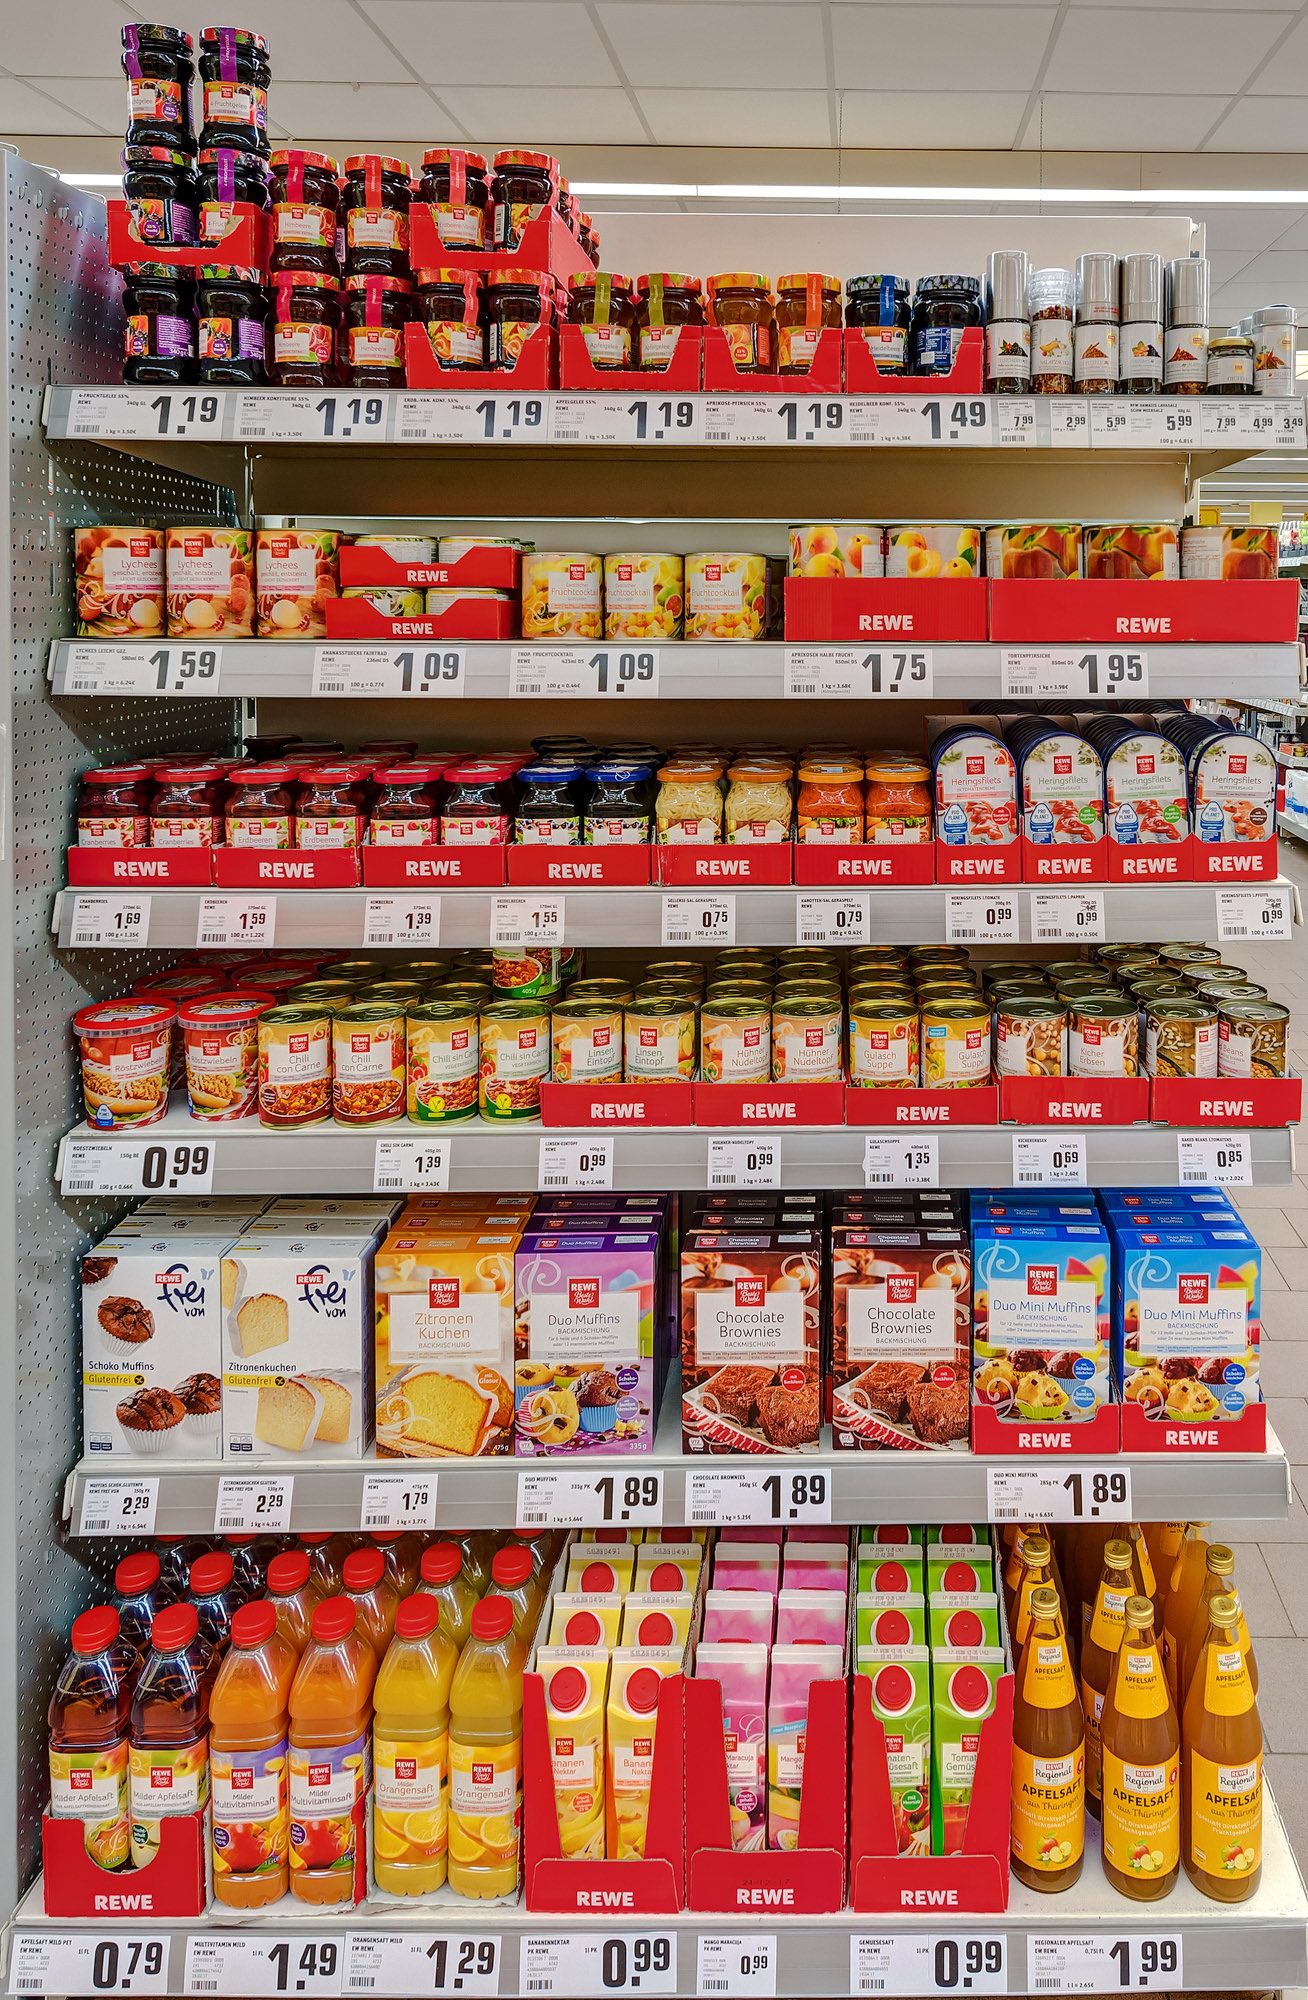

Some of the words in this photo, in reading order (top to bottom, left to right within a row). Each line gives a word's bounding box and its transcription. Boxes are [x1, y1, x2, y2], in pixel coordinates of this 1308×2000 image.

[150, 396, 218, 434] 1.19
[315, 398, 383, 436] 1.19
[476, 400, 542, 438] 1.19
[627, 401, 693, 439] 1.19
[777, 403, 843, 440] 1.19
[921, 402, 986, 439] 1.49
[1014, 416, 1033, 427] 7.99
[1066, 417, 1086, 428] 2.99
[1106, 417, 1126, 428] 5.99
[1167, 415, 1192, 431] 5.99
[1217, 417, 1236, 430] 7.99
[1253, 418, 1273, 429] 4.99
[1283, 418, 1303, 429] 3.49
[121, 560, 158, 569] Lychees
[178, 560, 212, 569] Lychees
[407, 570, 448, 582] REWE
[392, 623, 433, 635] REWE
[859, 615, 914, 631] REWE
[1116, 617, 1171, 633] REWE
[149, 650, 216, 690] 1.59
[393, 652, 460, 692] 1.09
[588, 653, 654, 692] 1.09
[861, 654, 926, 693] 1.75
[1078, 654, 1142, 693] 1.95
[951, 777, 1001, 788] Heringsfilets
[1038, 776, 1088, 786] Heringsfilets
[1211, 776, 1262, 785] Heringsfilets
[81, 838, 116, 846] Cranberries
[238, 836, 273, 844] Erdbeeren
[114, 862, 169, 877] REWE
[259, 863, 315, 878] REWE
[406, 861, 461, 876] REWE
[548, 864, 603, 878] REWE
[695, 860, 750, 875] REWE
[838, 860, 892, 875] REWE
[950, 859, 1005, 875] REWE
[1038, 858, 1092, 875] REWE
[1123, 857, 1178, 874] REWE
[1208, 855, 1263, 872] REWE
[114, 913, 141, 929] 1.69
[239, 913, 266, 929] 1.59
[405, 913, 432, 929] 1.39
[532, 912, 558, 928] 1.55
[702, 911, 728, 928] 0.75
[836, 911, 862, 927] 0.79
[986, 908, 1012, 925] 0.99
[1076, 912, 1097, 926] 0.99
[1262, 910, 1283, 924] 0.99
[289, 1054, 309, 1064] Chili
[588, 1047, 614, 1058] Linsen
[737, 1048, 765, 1058] Hühner
[864, 1050, 897, 1060] Gulasch
[1080, 1048, 1105, 1057] Kicher
[115, 1056, 165, 1073] Röstzwiebeln
[276, 1065, 293, 1073] con
[294, 1061, 321, 1072] Carne
[587, 1054, 616, 1067] Eintopf
[731, 1055, 769, 1067] Nudeltopf
[867, 1060, 894, 1069] Suppe
[1080, 1057, 1105, 1066] Erbsen
[591, 1104, 645, 1118] REWE
[742, 1103, 796, 1118] REWE
[896, 1106, 950, 1121] REWE
[1048, 1103, 1102, 1118] REWE
[1199, 1101, 1254, 1116] REWE
[414, 1156, 441, 1173] 1.39
[580, 1154, 606, 1171] 0.99
[747, 1153, 773, 1170] 0.99
[904, 1152, 930, 1169] 1.35
[1052, 1151, 1078, 1168] 0.69
[1217, 1151, 1242, 1168] 0.85
[142, 1146, 209, 1189] 0.99
[156, 1275, 181, 1283] REWE
[737, 1282, 763, 1290] REWE
[431, 1283, 458, 1291] REWE
[184, 1307, 205, 1317] von
[993, 1300, 1017, 1312] Duo
[1020, 1300, 1045, 1312] Mini
[1048, 1301, 1091, 1314] Muffins
[415, 1313, 473, 1325] Zitronen
[548, 1315, 572, 1326] Duo
[575, 1312, 620, 1325] Muffins
[716, 1311, 785, 1324] Chocolate
[419, 1327, 470, 1339] Kuchen
[558, 1327, 610, 1335] BACKMISCHUNG
[719, 1326, 781, 1338] Brownies
[724, 1340, 776, 1348] BACKMISCHUNG
[88, 1361, 119, 1371] Schoko
[121, 1362, 154, 1371] Muffins
[229, 1362, 296, 1372] Zitronenkuchen
[88, 1374, 131, 1384] Glutenfrei
[229, 1376, 272, 1385] Glutenfrei
[1018, 1433, 1072, 1448] REWE
[1165, 1430, 1219, 1445] REWE
[402, 1492, 428, 1510] 1.79
[594, 1477, 659, 1520] 1.89
[762, 1475, 825, 1518] 1.89
[1063, 1474, 1126, 1516] 1.89
[122, 1496, 149, 1515] 2.29
[256, 1495, 283, 1513] 2.29
[1125, 1675, 1157, 1684] APFELSAFT
[780, 1755, 802, 1763] Mango
[554, 1767, 576, 1775] Nektar
[1022, 1777, 1082, 1799] APFELSAFT
[1125, 1774, 1164, 1787] Regional
[53, 1793, 76, 1801] Milder
[77, 1792, 114, 1802] Apfelsaft
[232, 1793, 254, 1801] Milder
[379, 1784, 434, 1796] Orangensaft
[1113, 1787, 1174, 1808] APFELSAFT
[214, 1797, 276, 1808] Multivitaminsaft
[94, 1894, 153, 1910] REWE
[577, 1891, 634, 1906] REWE
[736, 1889, 794, 1905] REWE
[901, 1890, 958, 1905] REWE
[92, 1942, 163, 1989] 0.79
[268, 1943, 338, 1990] 1.49
[426, 1940, 495, 1988] 1.29
[602, 1938, 670, 1988] 0.99
[741, 1956, 768, 1975] 0.99
[934, 1940, 1001, 1987] 0.99
[1109, 1941, 1177, 1986] 1.99
